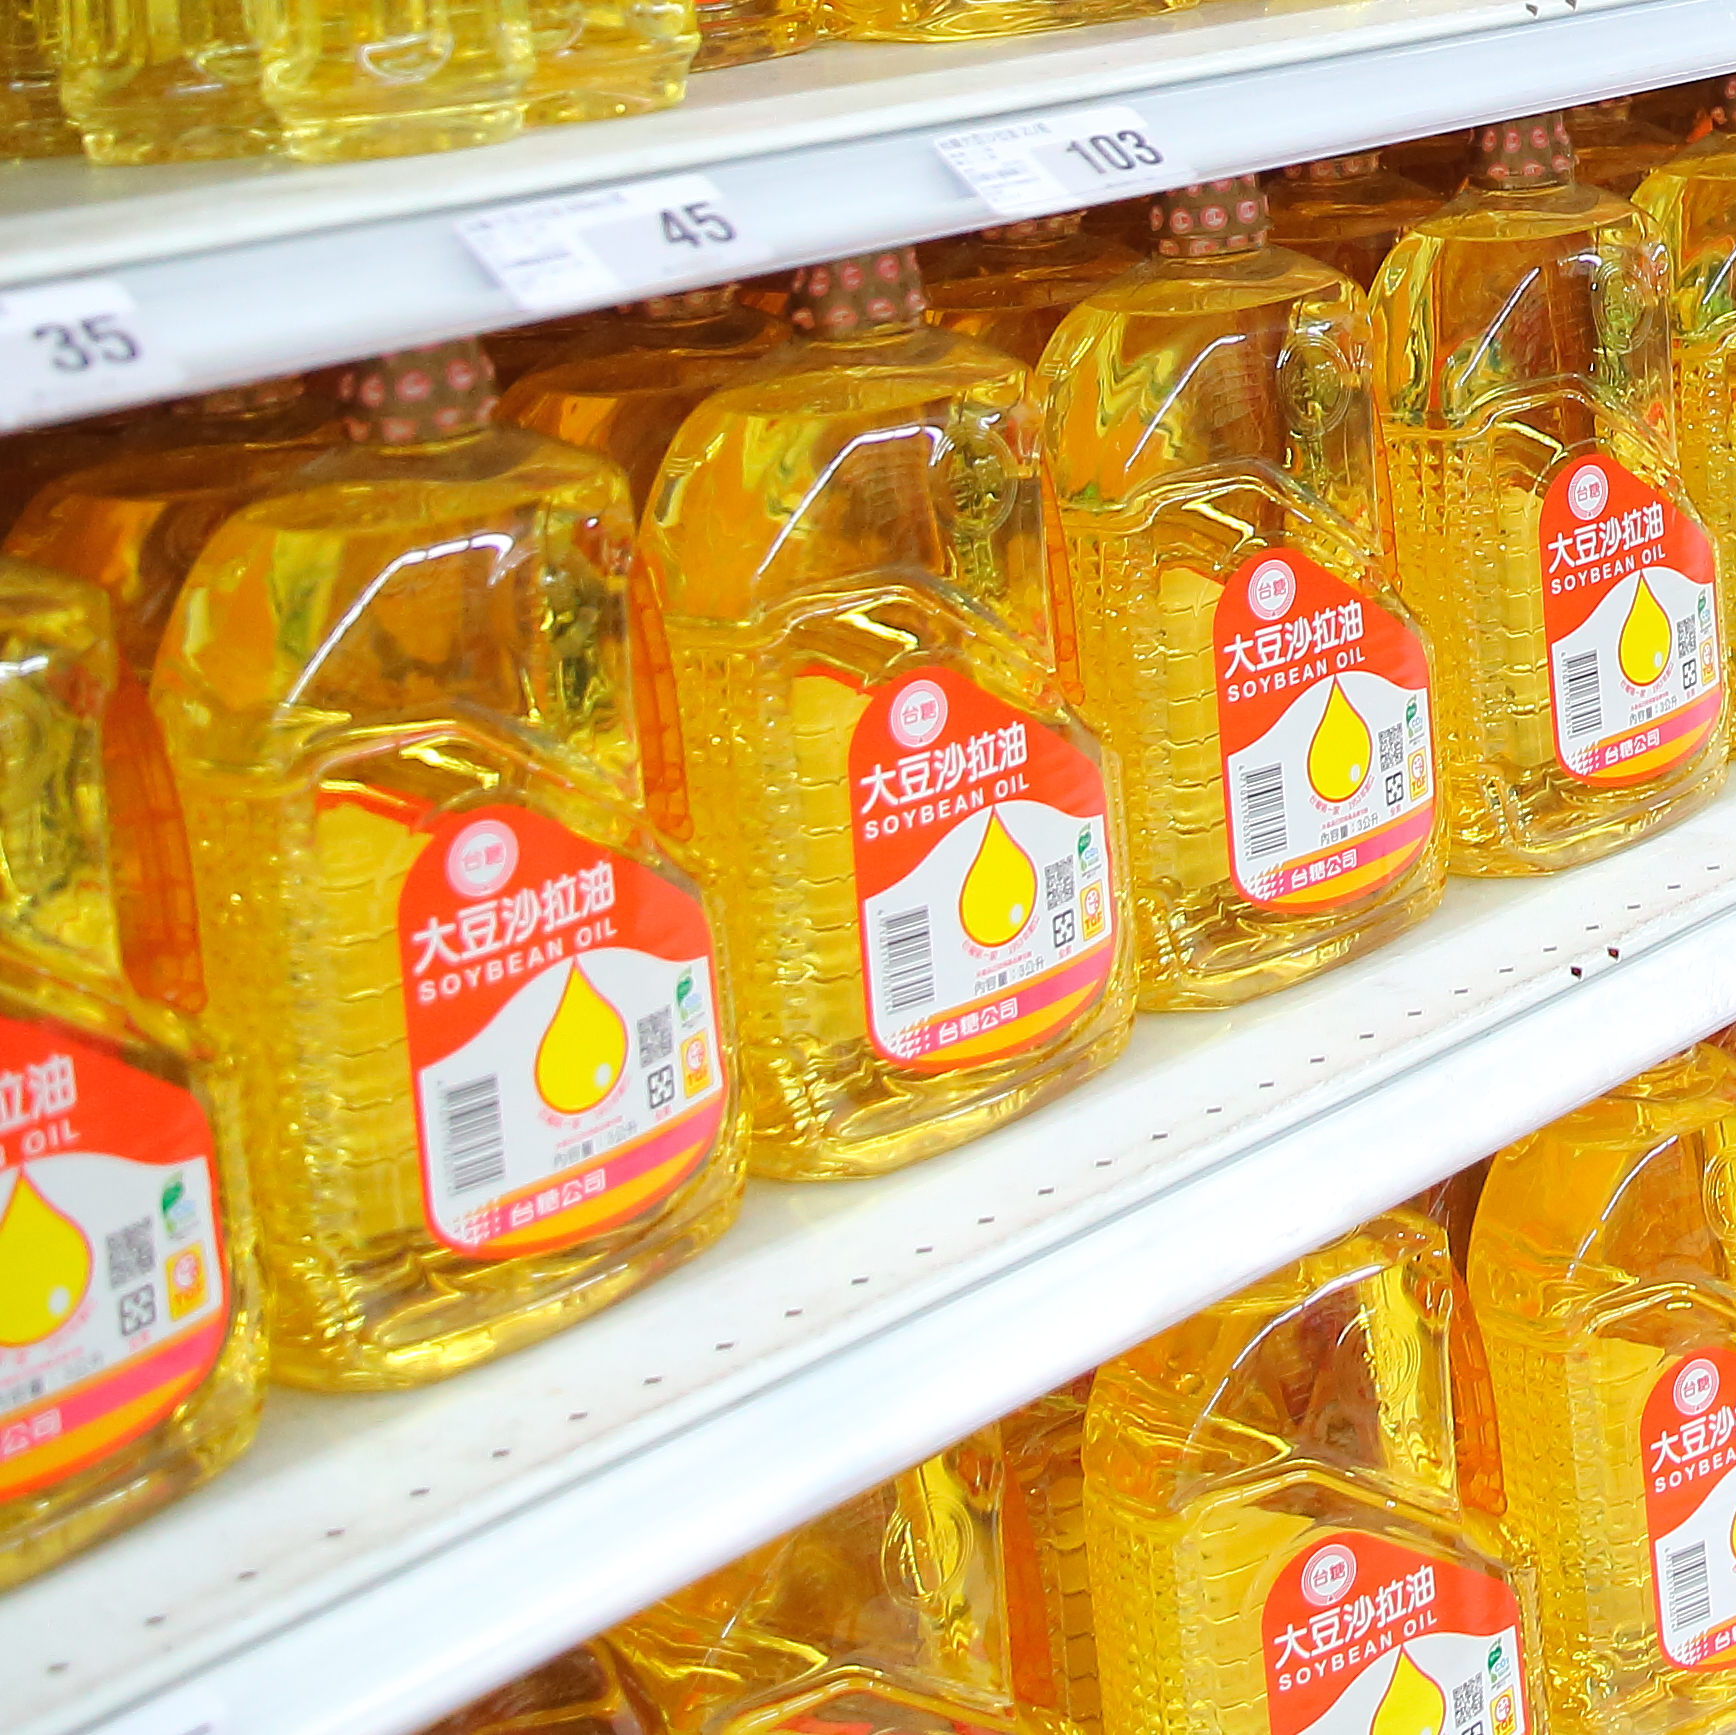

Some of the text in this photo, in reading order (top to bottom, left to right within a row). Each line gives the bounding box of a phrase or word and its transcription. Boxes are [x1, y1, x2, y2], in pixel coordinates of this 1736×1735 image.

[1066, 130, 1165, 174] 103
[660, 199, 737, 251] 45
[35, 313, 138, 372] 35
[1577, 484, 1602, 505] 台糖
[1547, 501, 1665, 574] 大豆沙拉油
[1256, 580, 1286, 602] 台糖
[1551, 543, 1667, 595] SOYBEAN OIL
[1222, 598, 1365, 679] 大豆沙拉油
[1226, 646, 1366, 703] SOYBEAN OIL
[901, 700, 937, 726] 台糖
[859, 721, 1028, 816] 大豆沙拉油
[1604, 727, 1661, 766] 台糖公司
[864, 773, 1030, 841] SOYBEAN OIL
[1291, 848, 1358, 889] 台糖公司
[411, 862, 616, 973] 大豆沙拉油
[417, 918, 619, 1004] SOYBEAN OIL
[939, 997, 1018, 1044] 台糖公司
[20, 1124, 80, 1154] OIL
[508, 1168, 608, 1228] 台糖公司
[1680, 1375, 1711, 1398] 台糖
[1310, 1561, 1347, 1591] 台糖
[1273, 1565, 1438, 1672] 大豆沙拉油
[1278, 1611, 1438, 1692] SOYBEAN OIL
[1495, 1714, 1514, 1733] TQF
